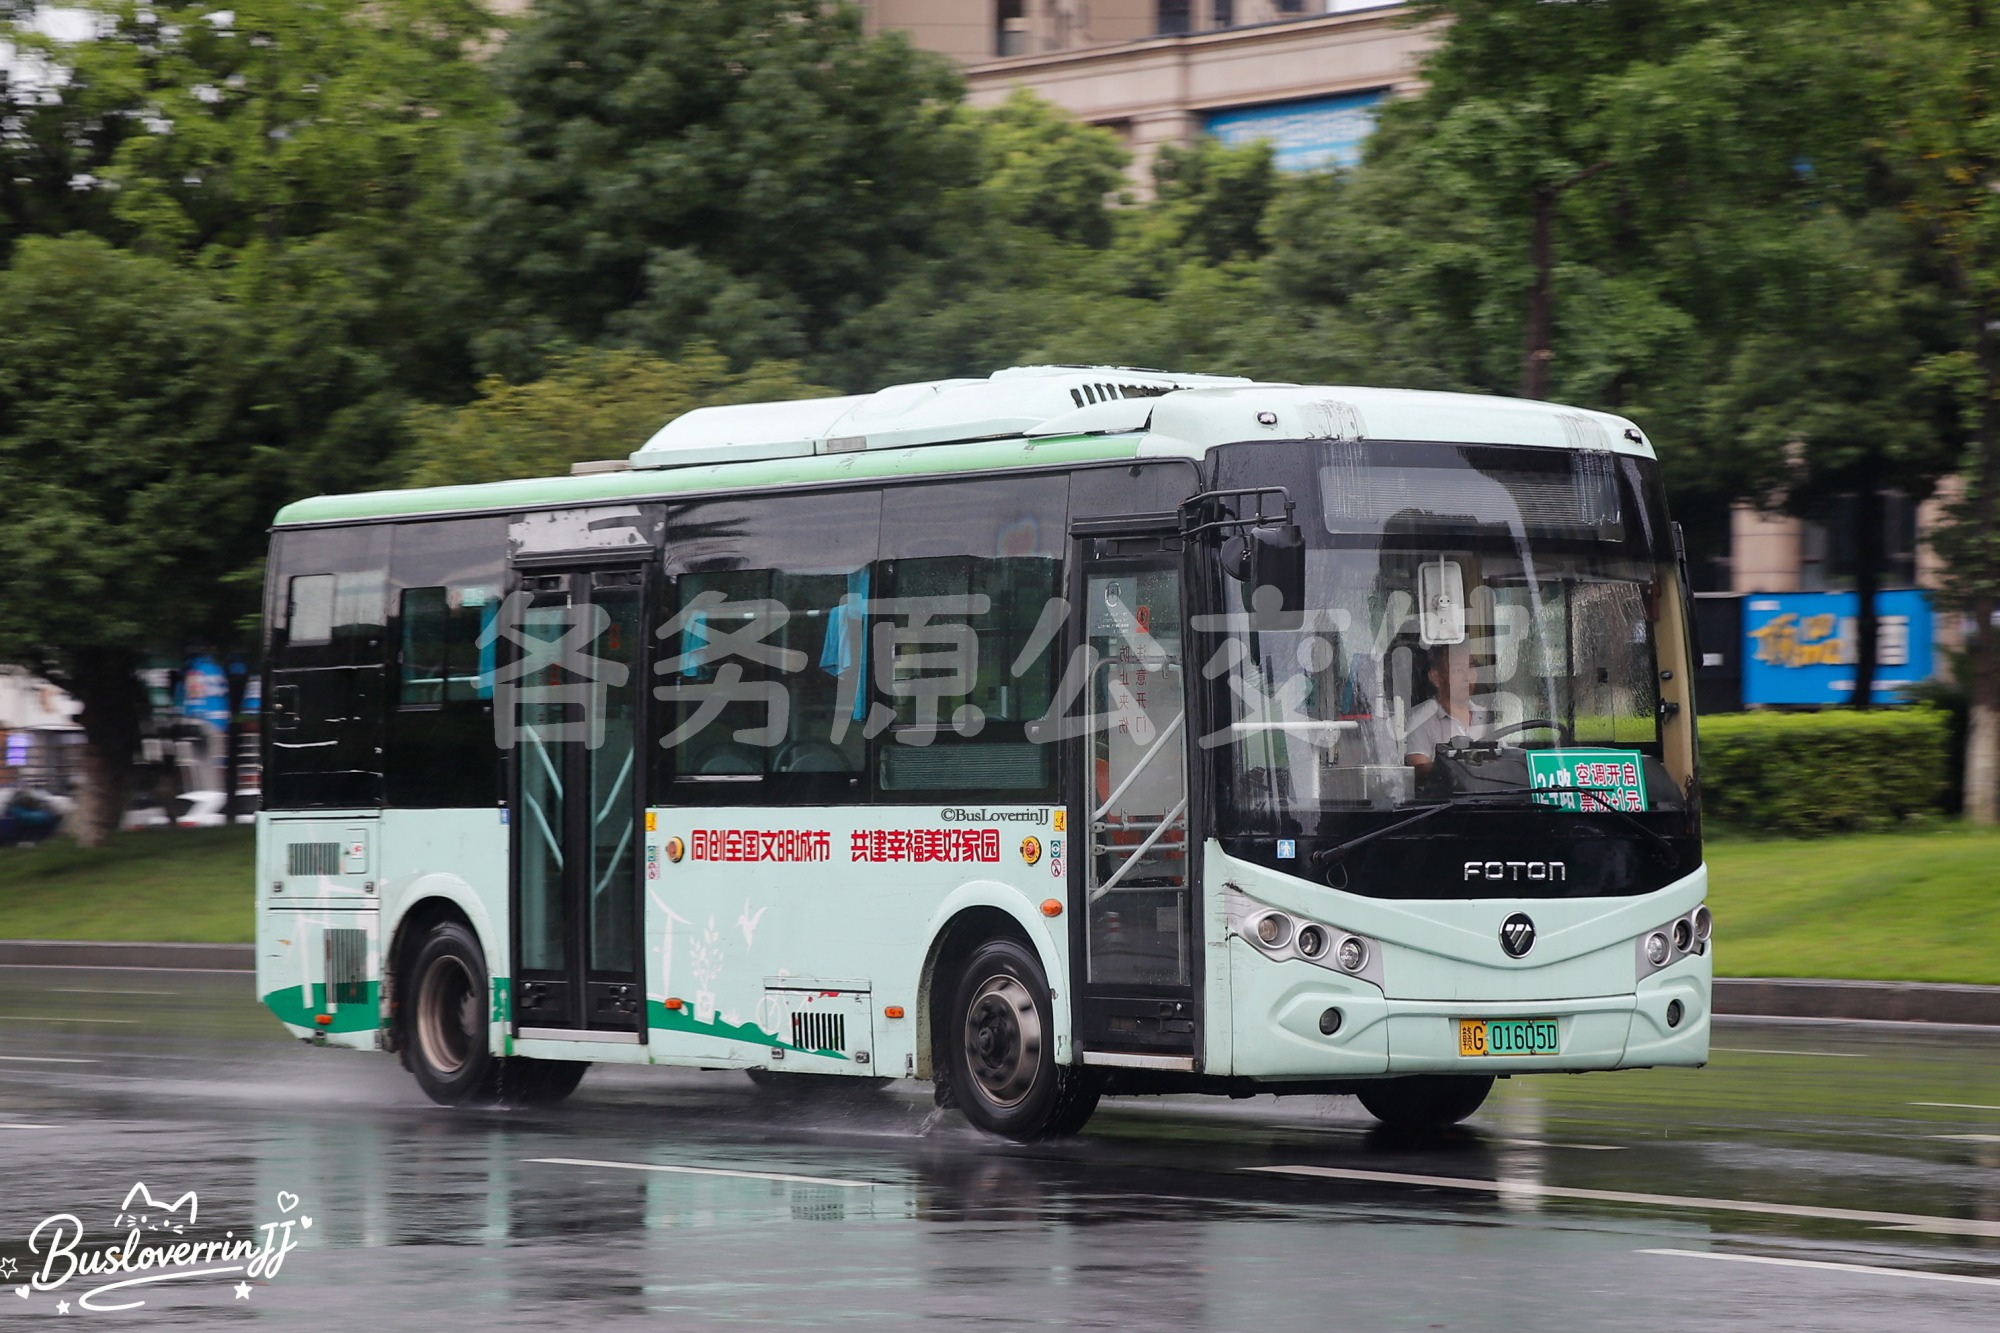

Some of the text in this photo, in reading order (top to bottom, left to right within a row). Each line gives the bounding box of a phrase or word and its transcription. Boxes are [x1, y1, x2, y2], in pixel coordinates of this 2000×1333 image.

[1574, 762, 1638, 787] 空调开启
[691, 828, 1001, 863] 同创全国文明城市 共建幸福美好家园
[1463, 861, 1567, 881] FOTON
